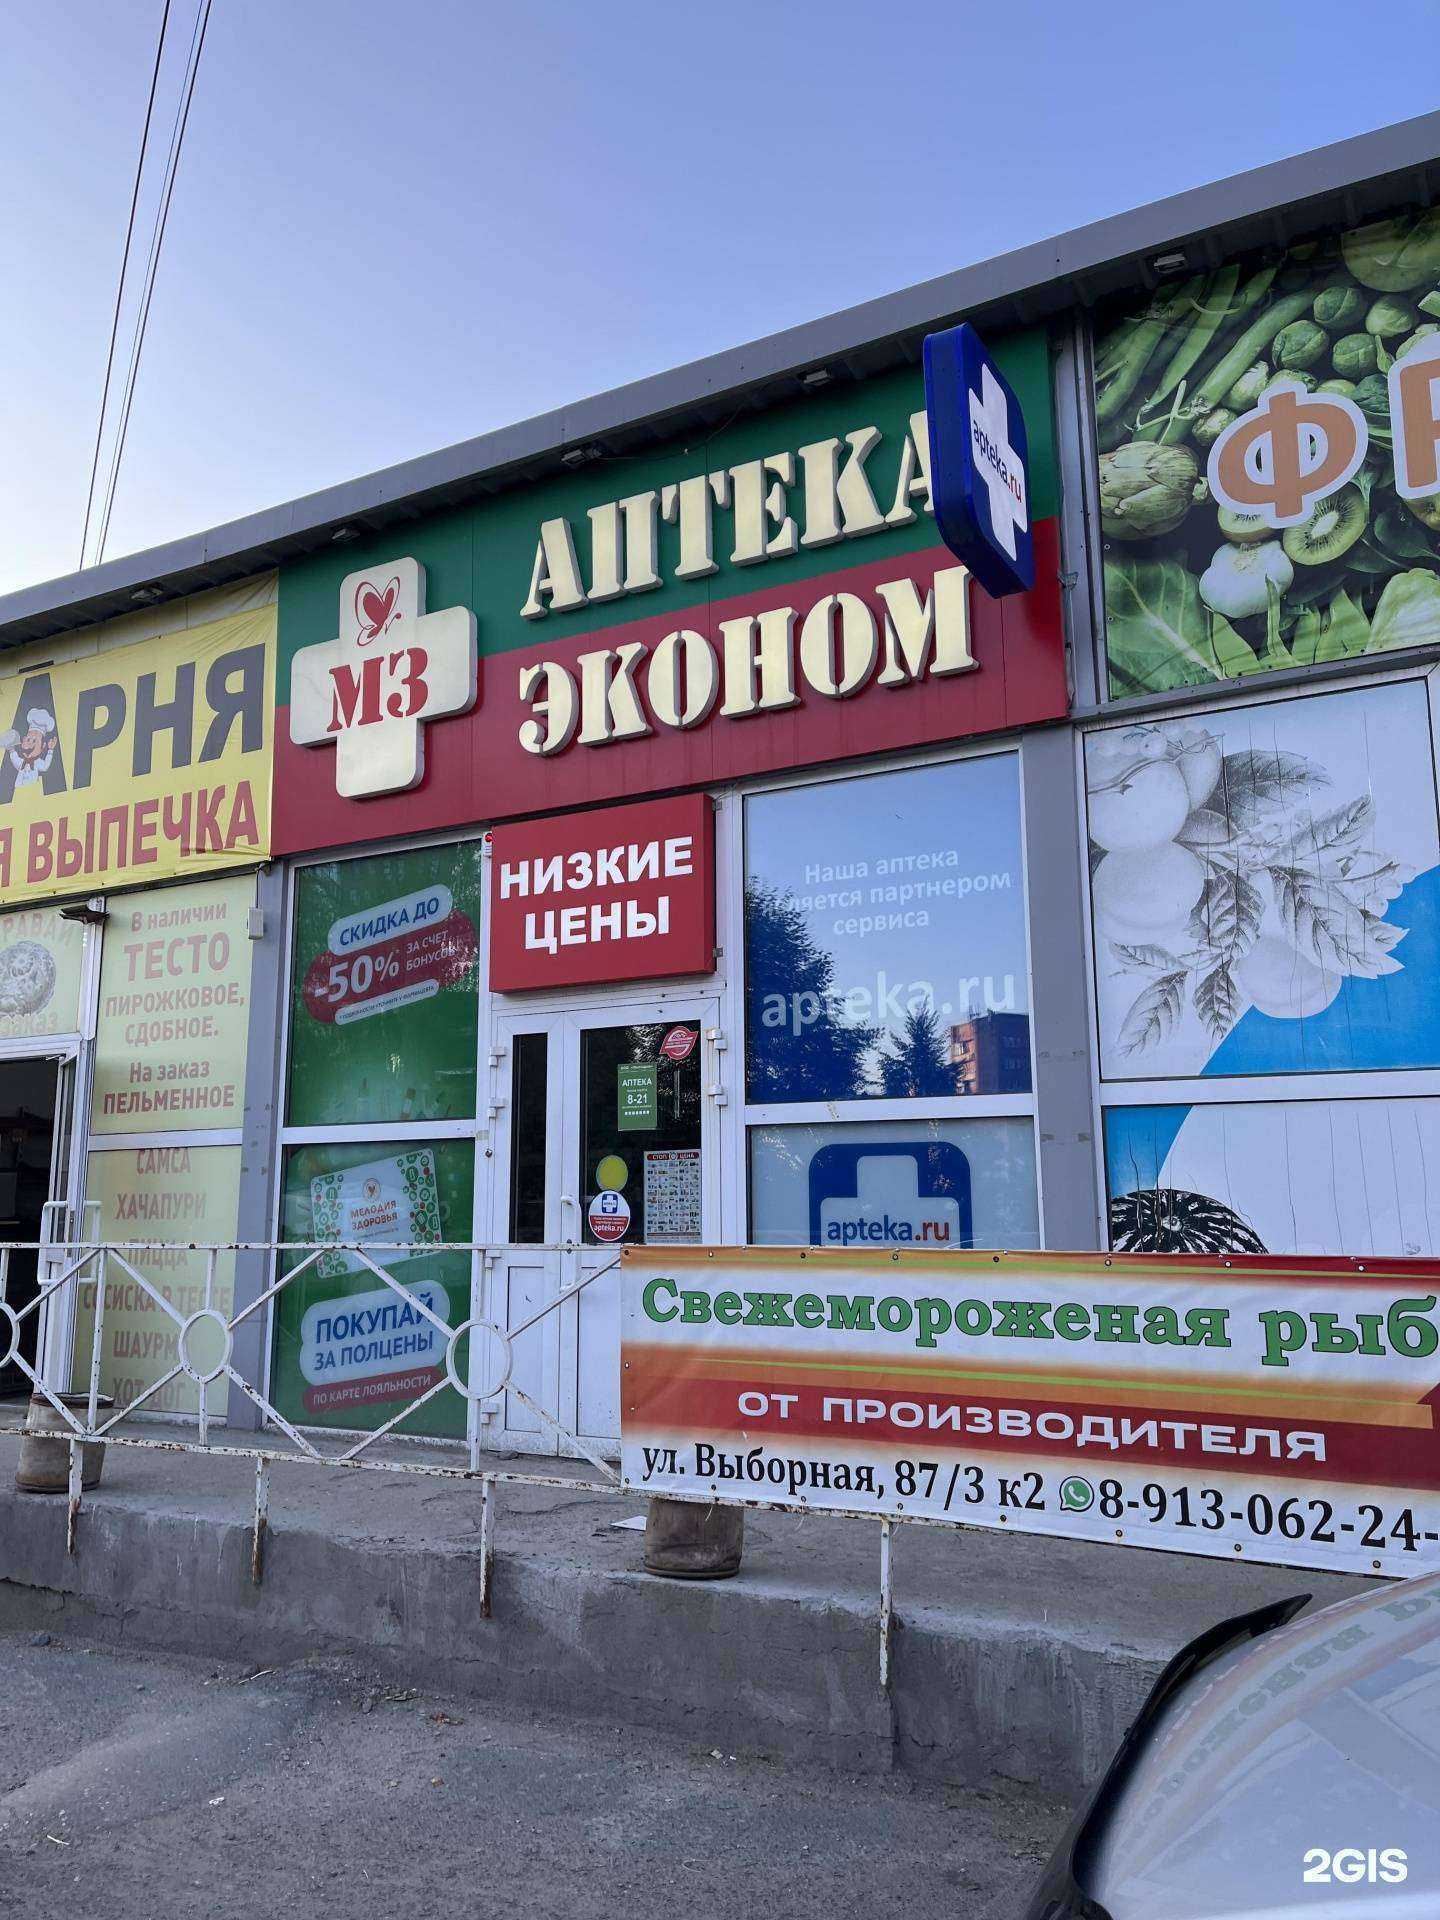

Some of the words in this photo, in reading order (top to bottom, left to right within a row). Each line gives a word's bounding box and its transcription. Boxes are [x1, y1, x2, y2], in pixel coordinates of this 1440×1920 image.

[973, 420, 1022, 503] apteka.ru
[520, 410, 936, 620] АПТЕКА
[518, 566, 980, 757] ЭКОНОМ
[0, 643, 265, 804] АРНЯ
[27, 780, 259, 884] ВЫПЕЧКА
[501, 836, 693, 900] НИЗКИЕ
[804, 862, 868, 885] Наша
[876, 851, 959, 876] аптека
[871, 871, 1012, 906] партнером
[131, 911, 142, 933] В
[148, 903, 227, 930] наличии
[340, 907, 409, 946] СКИДКА
[413, 897, 439, 924] ДО
[525, 896, 670, 955] ЦЕНЫ
[833, 910, 929, 937] сервиса
[124, 932, 230, 982] ТЕСТО
[405, 941, 420, 954] ЗА
[422, 930, 449, 948] СЧЕТ
[406, 947, 457, 972] БОНУСОВ
[105, 982, 245, 1018] ПИРОЖКОВОЕ,
[125, 1016, 219, 1048] СДОБНОЕ.
[129, 1062, 152, 1083] На
[156, 1060, 210, 1081] заказ
[621, 1078, 652, 1087] АПТЕКА
[103, 1084, 235, 1115] ПЕЛЬМЕННОЕ
[627, 1094, 648, 1104] 8-21
[136, 1147, 191, 1175] САМСА
[115, 1192, 207, 1220] ХАЧАПУРИ
[351, 1200, 397, 1219] МЕЛОДИЯ
[352, 1212, 398, 1231] ЗДОРОВЬЯ
[827, 1215, 950, 1246] apteka.ru
[128, 1238, 188, 1272] ПИЦЦА
[315, 1292, 433, 1344] ПОКУПАЙ
[643, 1279, 1231, 1347] Свежемороженая
[1259, 1296, 1438, 1366] рыб
[113, 1330, 176, 1360] ШАУРМ
[314, 1351, 336, 1371] ЗА
[341, 1331, 433, 1366] ПОЛЦЕНЫ
[313, 1393, 327, 1406] ПО
[329, 1387, 360, 1402] КАРТЕ
[362, 1375, 431, 1397] ЛОЯЛЬНОСТИ
[738, 1392, 798, 1418] ОТ
[823, 1397, 1326, 1462] ПРОИЗВОДИТЕЛЯ
[643, 1445, 685, 1481] ул.
[695, 1443, 884, 1498] Выборная,
[895, 1460, 984, 1510] 87/3
[999, 1473, 1045, 1510] к2
[1100, 1478, 1439, 1552] 8-913-062-24-
